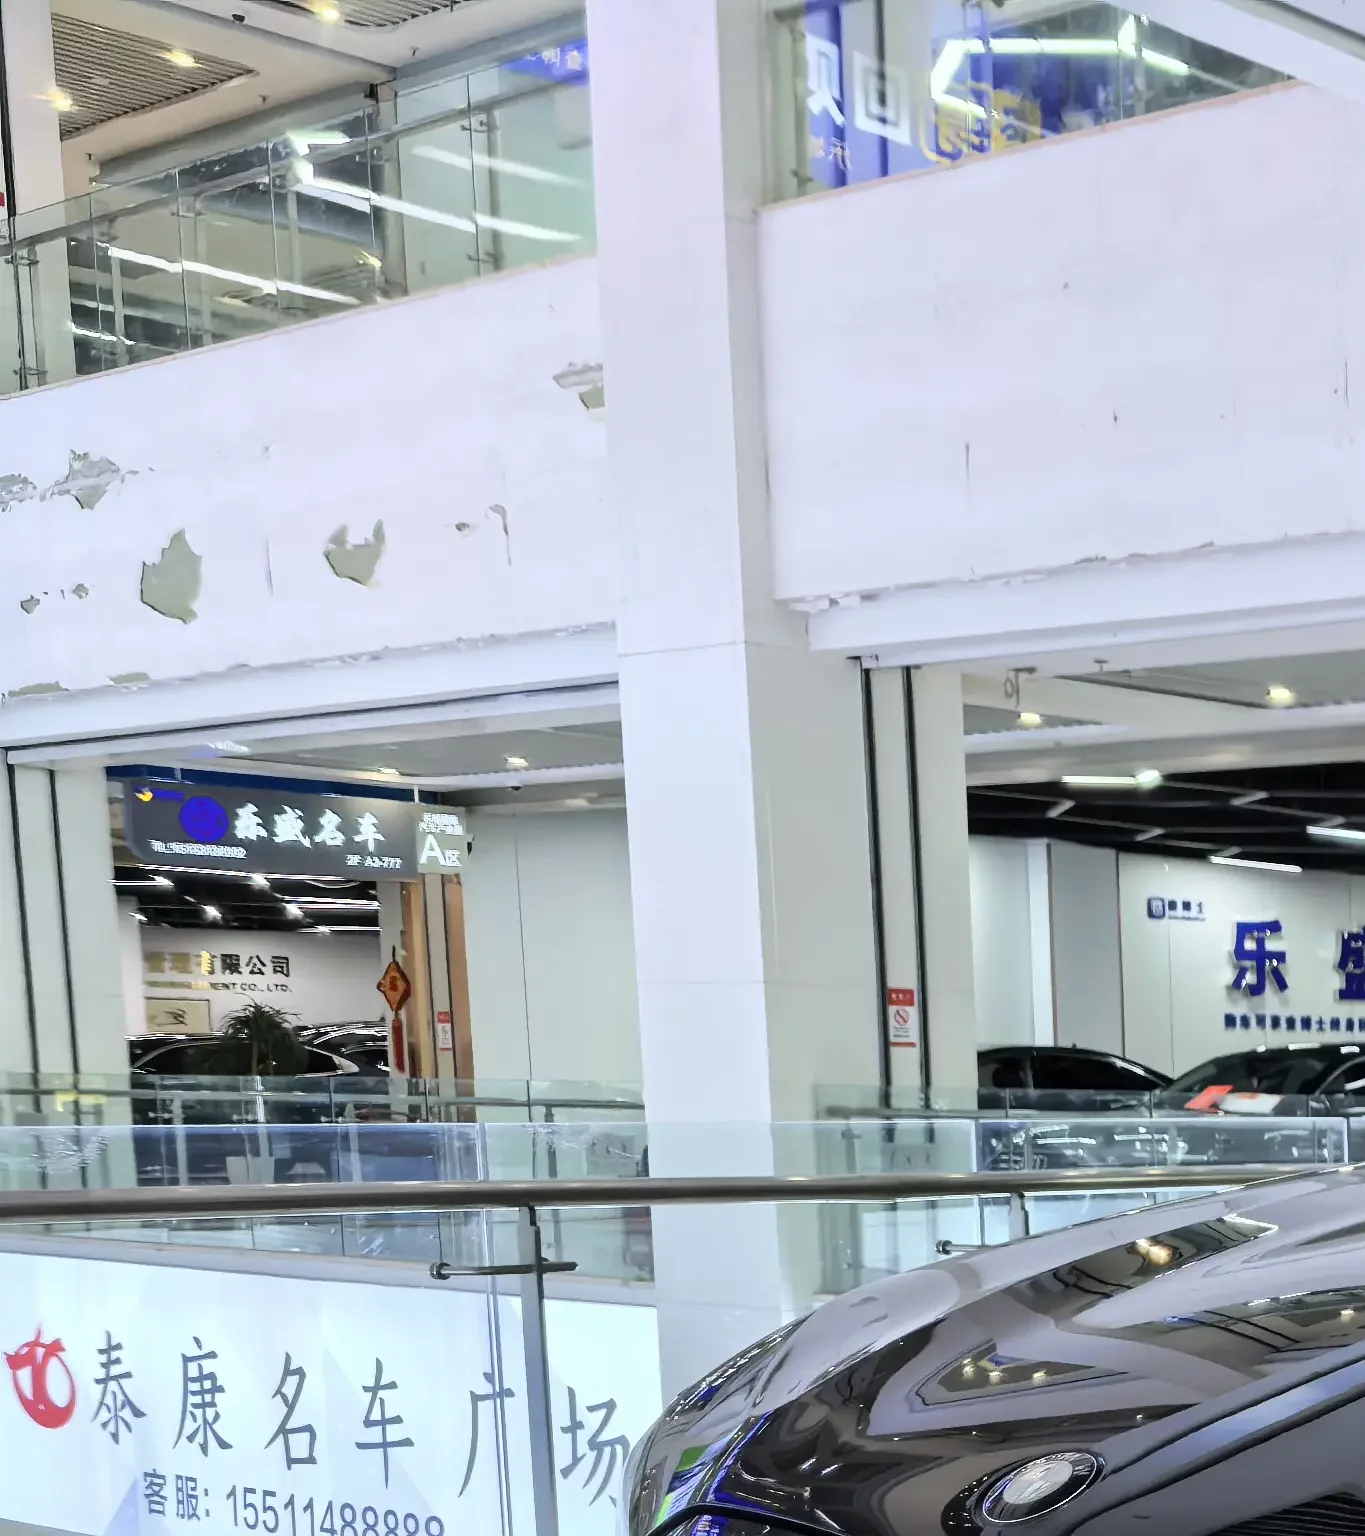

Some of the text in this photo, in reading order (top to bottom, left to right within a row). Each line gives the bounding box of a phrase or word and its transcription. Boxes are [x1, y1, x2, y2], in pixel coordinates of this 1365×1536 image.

[91, 1328, 631, 1508] 泰康名车广场
